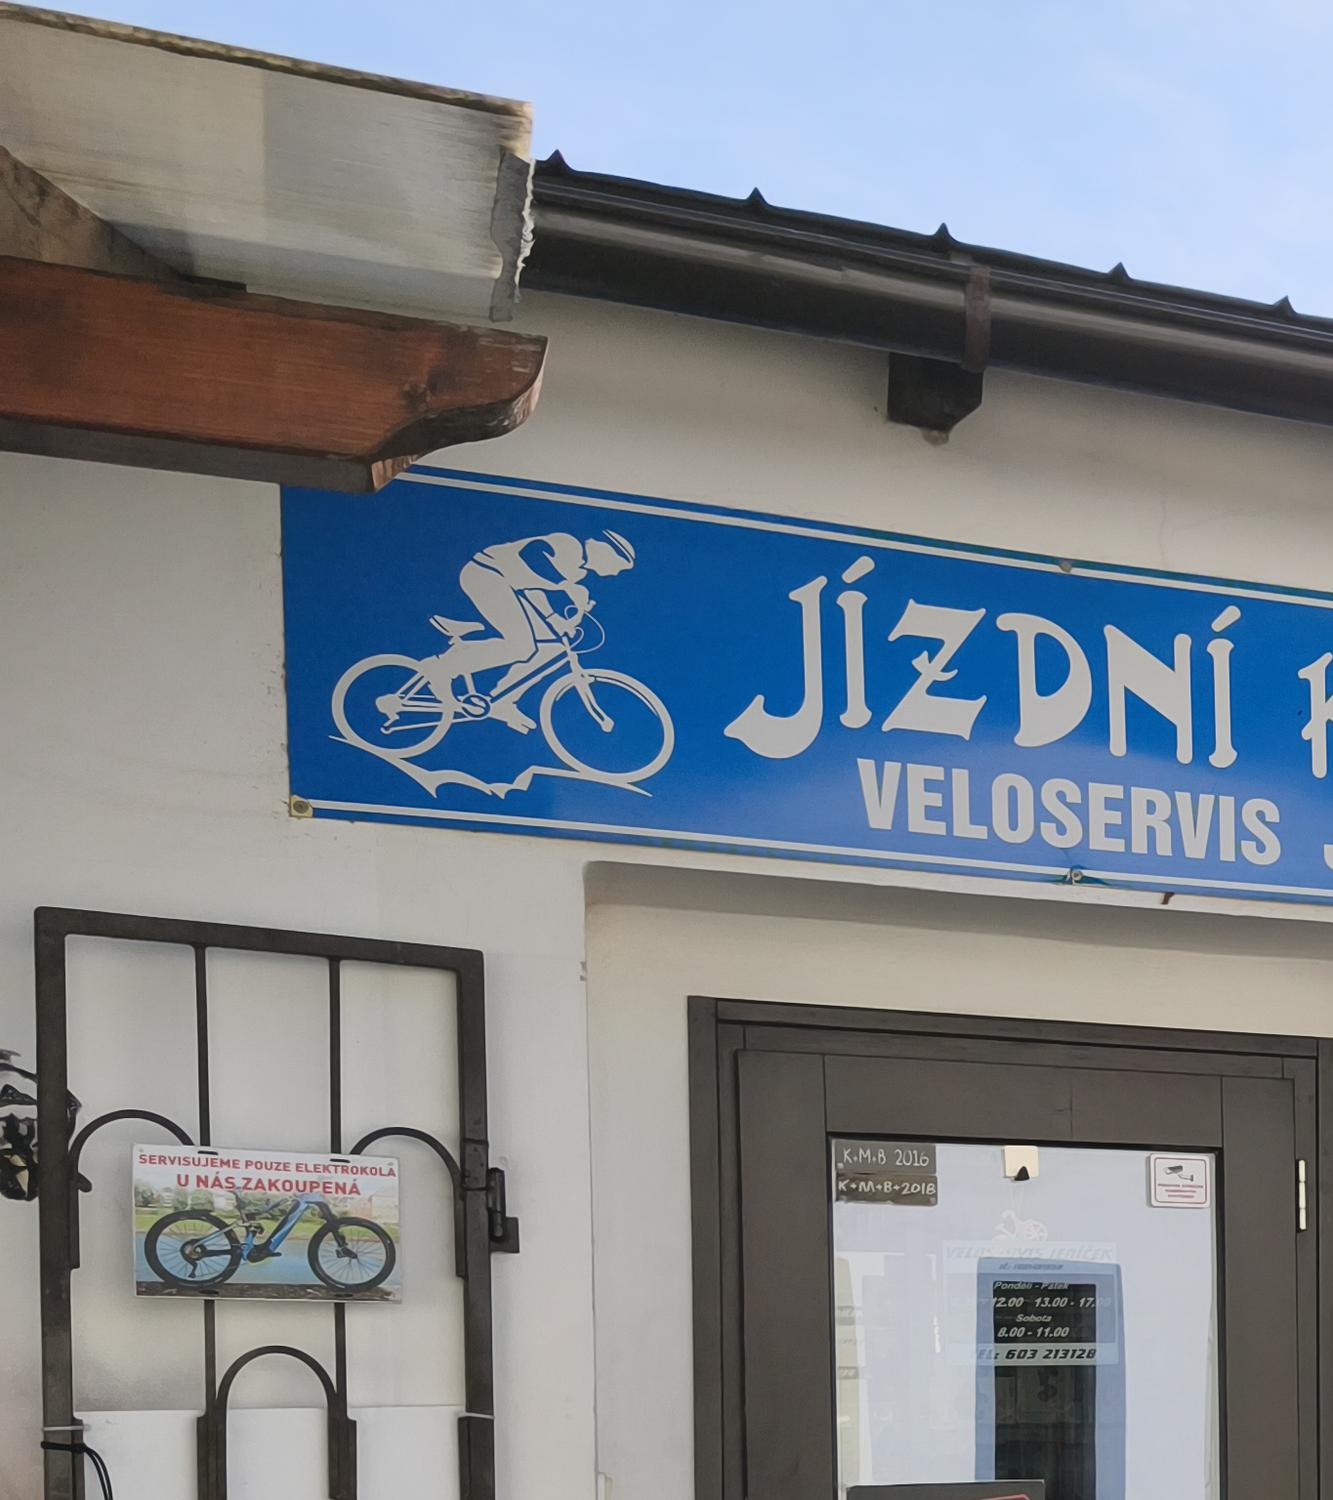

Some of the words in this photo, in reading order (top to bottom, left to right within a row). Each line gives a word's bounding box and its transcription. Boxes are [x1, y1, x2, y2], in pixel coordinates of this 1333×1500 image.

[724, 555, 1242, 769] JÍZDNÍ
[857, 758, 1282, 866] VELOSERVIS
[138, 1153, 241, 1170] SERVISUJEME
[244, 1159, 291, 1172] POUZE
[295, 1162, 397, 1177] ELEKTROKOLA
[895, 1148, 930, 1167] 2016
[176, 1173, 189, 1187] U
[195, 1171, 237, 1190] NÁS
[241, 1178, 361, 1196] ZAKOUPENÁ
[1034, 1296, 1068, 1308] 13.00
[1015, 1313, 1053, 1323] Sobota
[1036, 1326, 1070, 1338] 11.00
[1004, 1348, 1039, 1360] 603
[1042, 1347, 1098, 1360] 213128
